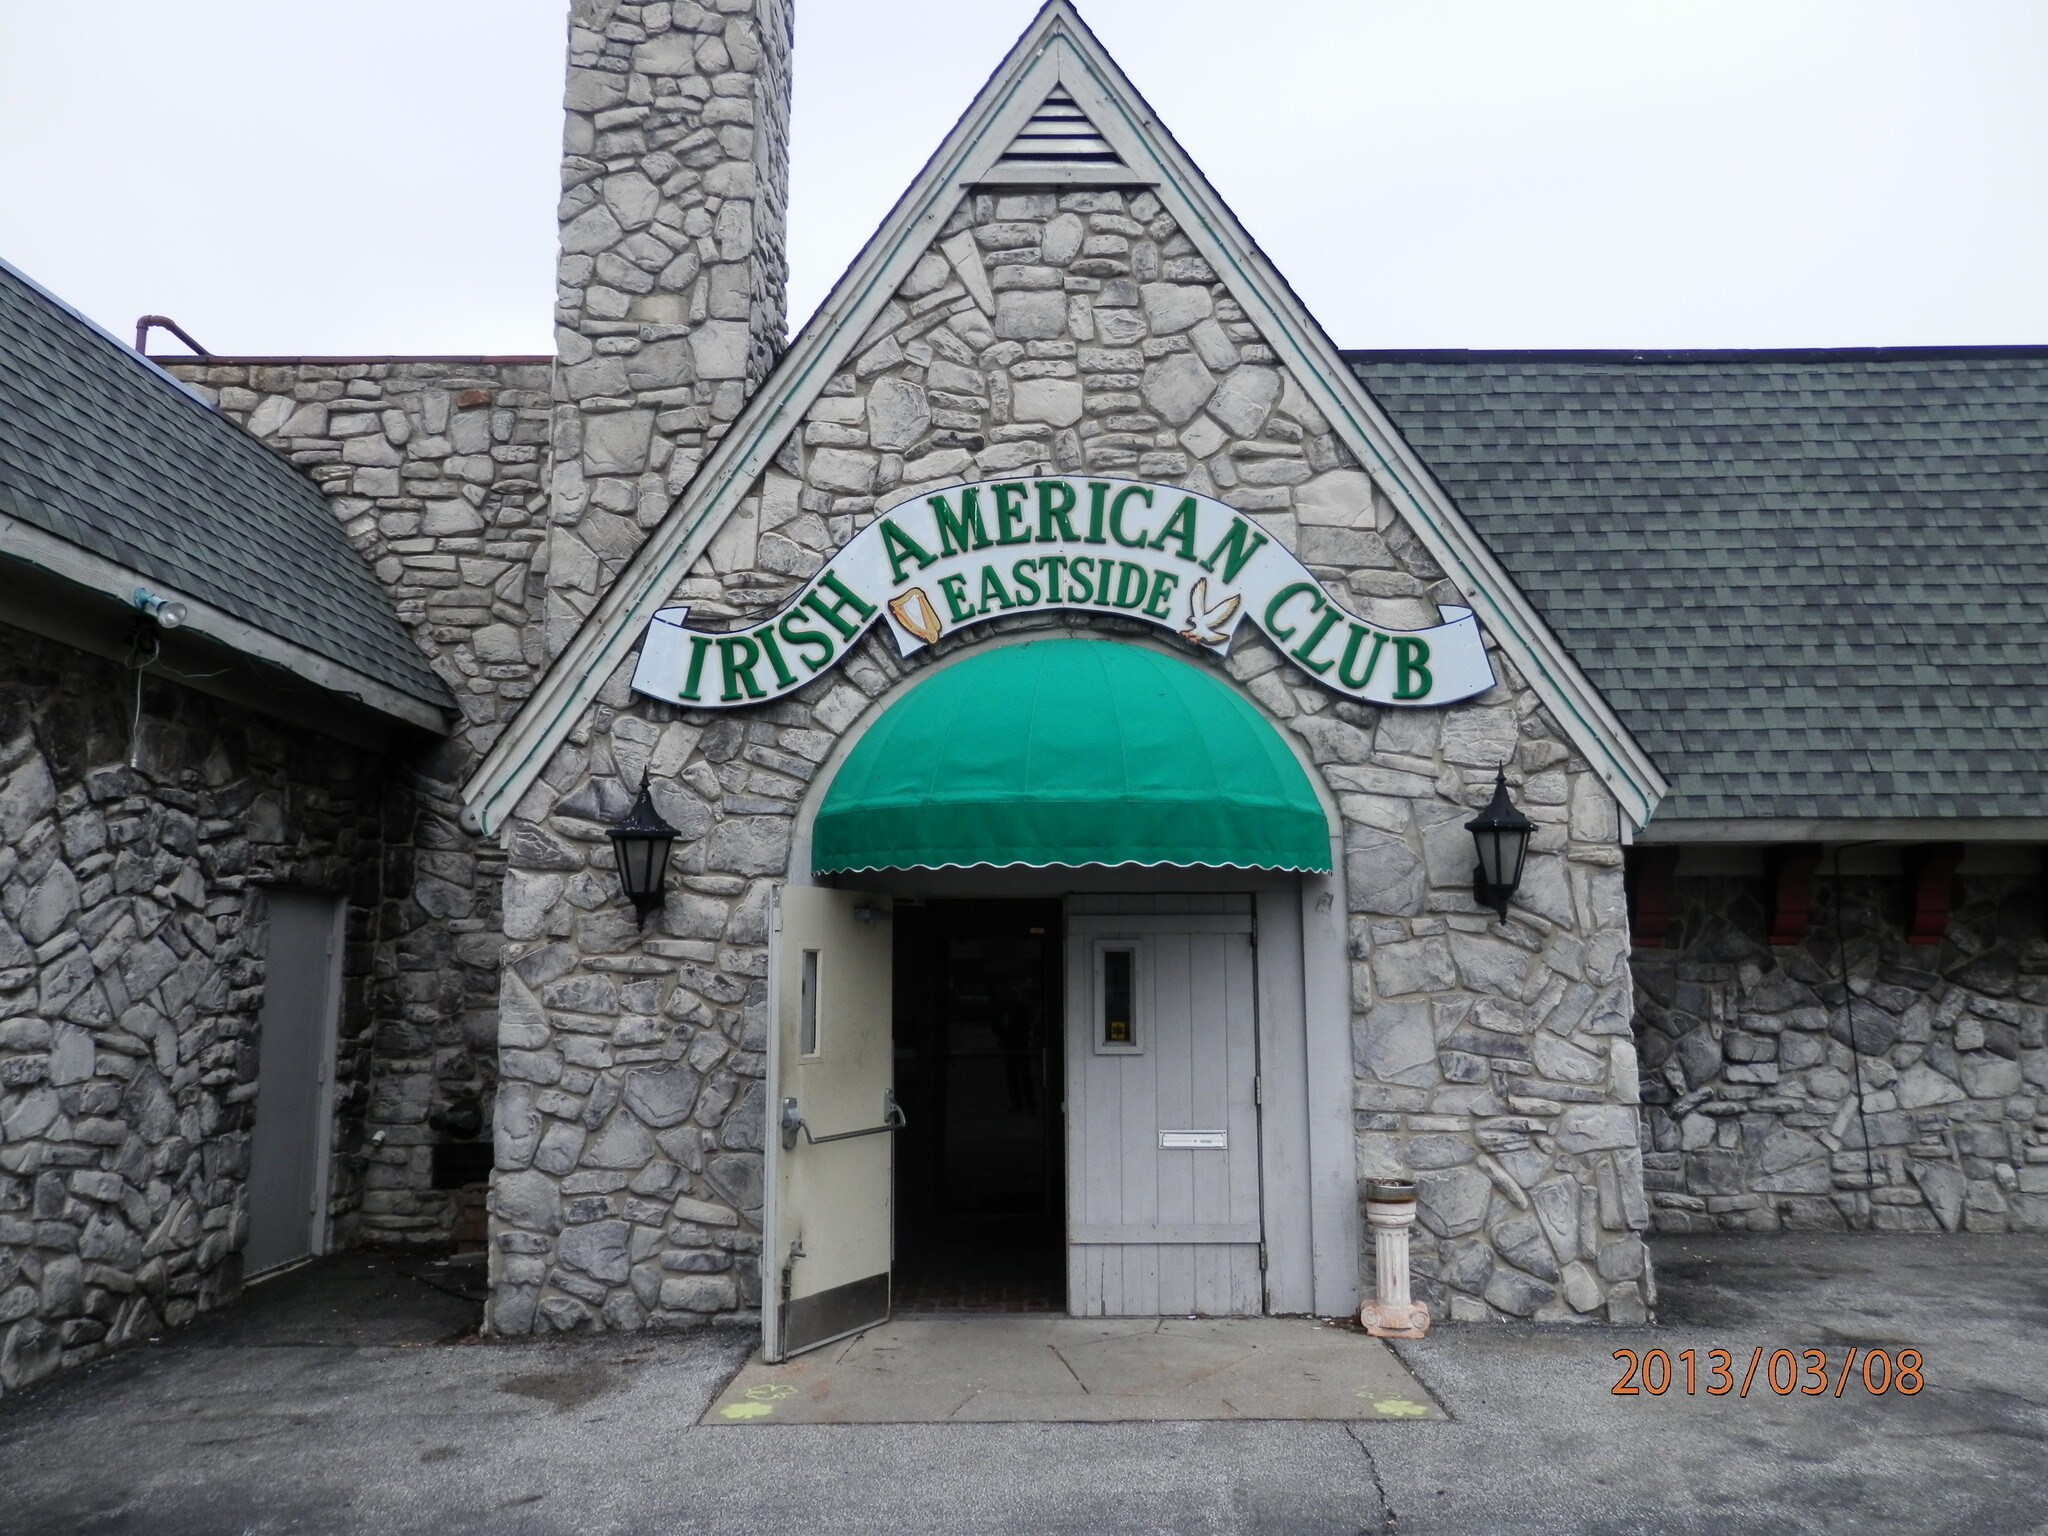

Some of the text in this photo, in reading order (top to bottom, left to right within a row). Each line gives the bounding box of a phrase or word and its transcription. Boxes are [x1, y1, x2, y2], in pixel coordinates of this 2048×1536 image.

[678, 480, 1434, 702] IRISH AMERICAN CLUB
[937, 555, 1178, 623] EASTSIDE
